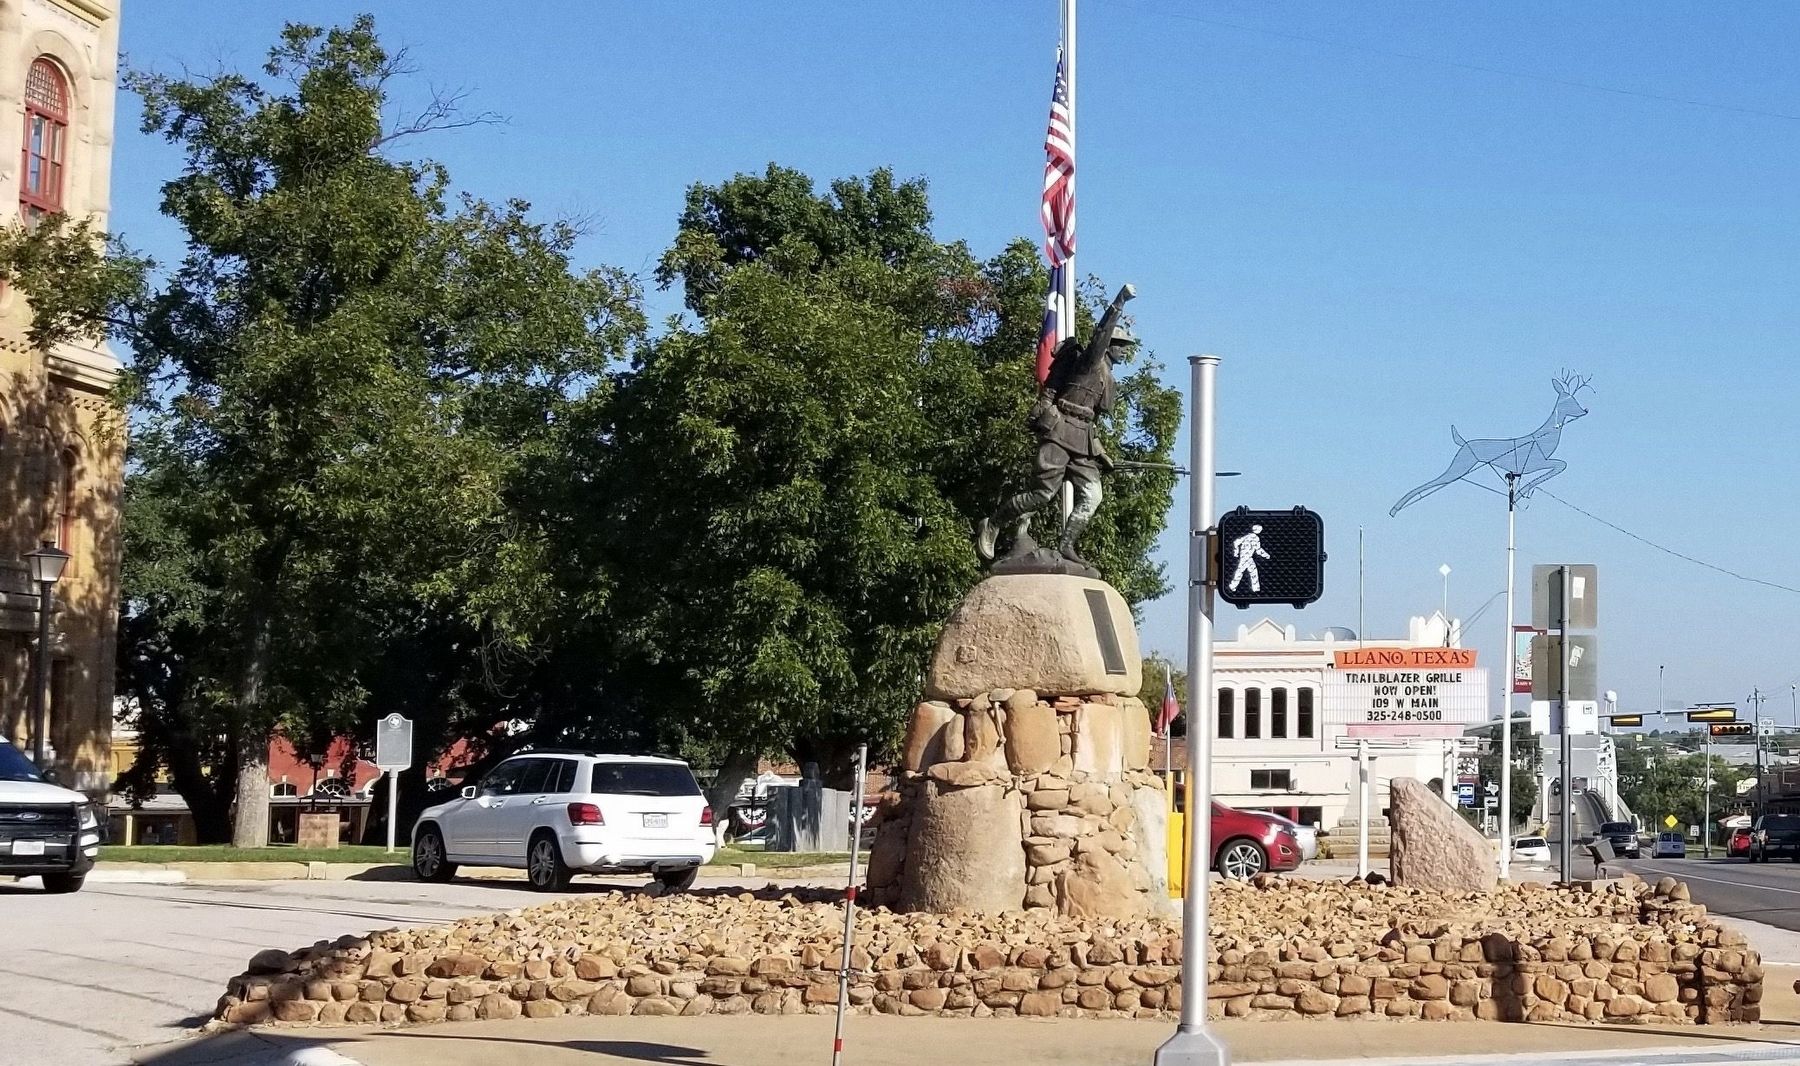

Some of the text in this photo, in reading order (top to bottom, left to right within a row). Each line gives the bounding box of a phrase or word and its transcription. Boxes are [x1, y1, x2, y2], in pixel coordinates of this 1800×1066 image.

[1411, 651, 1470, 665] TEXAS
[1346, 673, 1462, 683] TRAILBLAZER GRILLE
[1374, 685, 1436, 695] NOW OPEN!
[1372, 698, 1439, 708] 109 W MAIN
[1367, 710, 1442, 721] 325-248-0500
